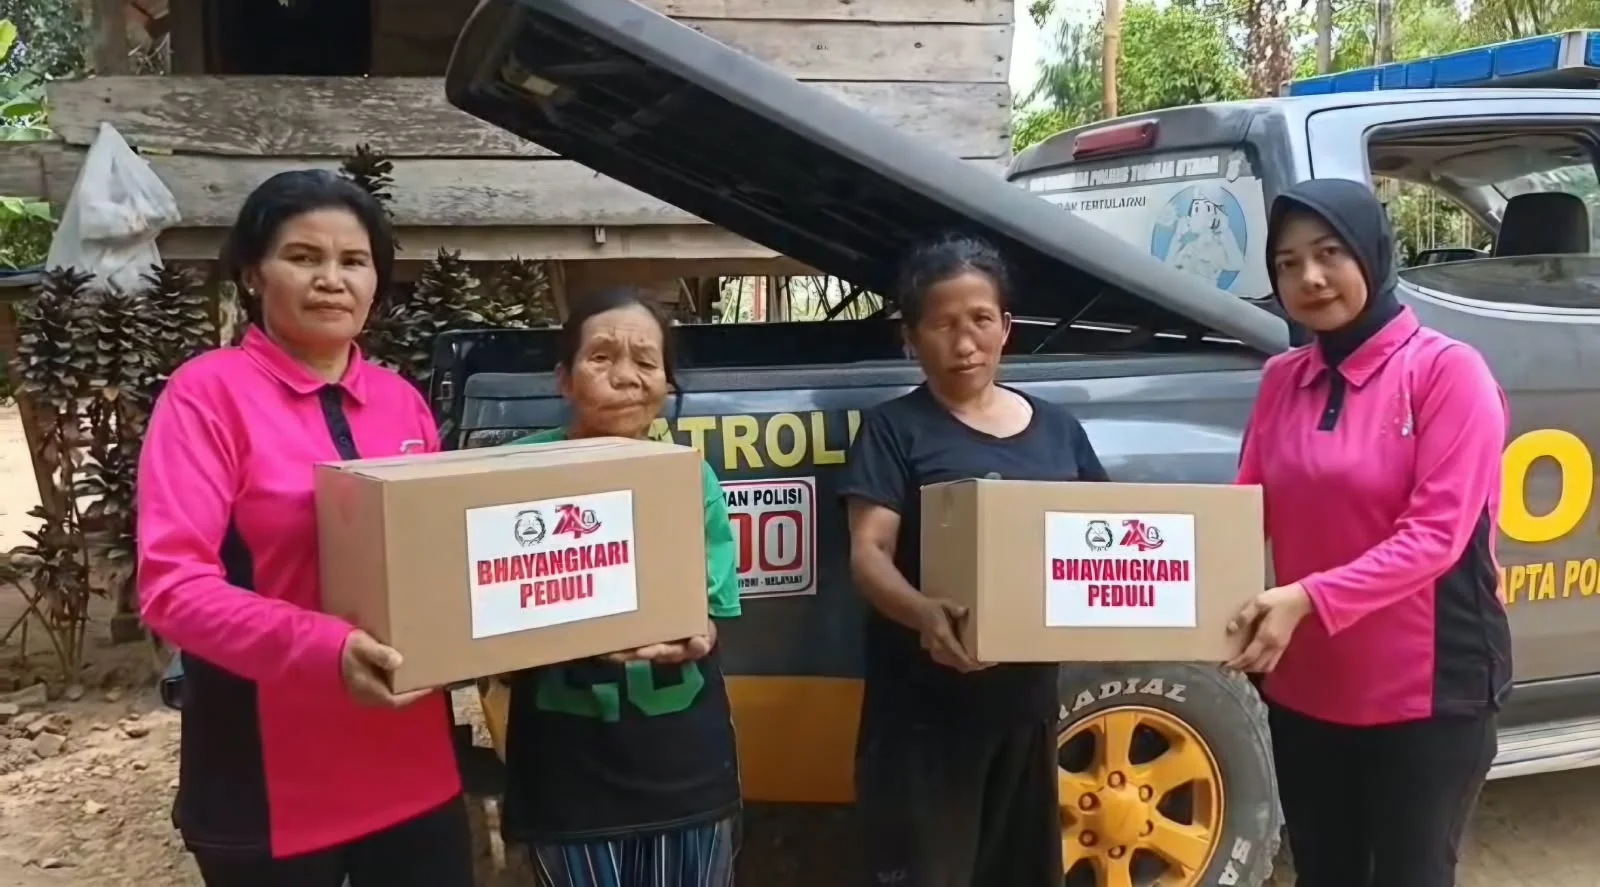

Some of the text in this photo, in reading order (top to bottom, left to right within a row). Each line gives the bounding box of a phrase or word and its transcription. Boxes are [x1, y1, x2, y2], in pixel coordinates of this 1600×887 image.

[754, 487, 802, 506] POLISI
[477, 540, 629, 585] BHAYANGKARI
[1052, 558, 1189, 582] BHAYANGKARI
[520, 573, 593, 609] PEDULI
[1563, 558, 1600, 598] PO
[1088, 585, 1155, 607] PEDULI
